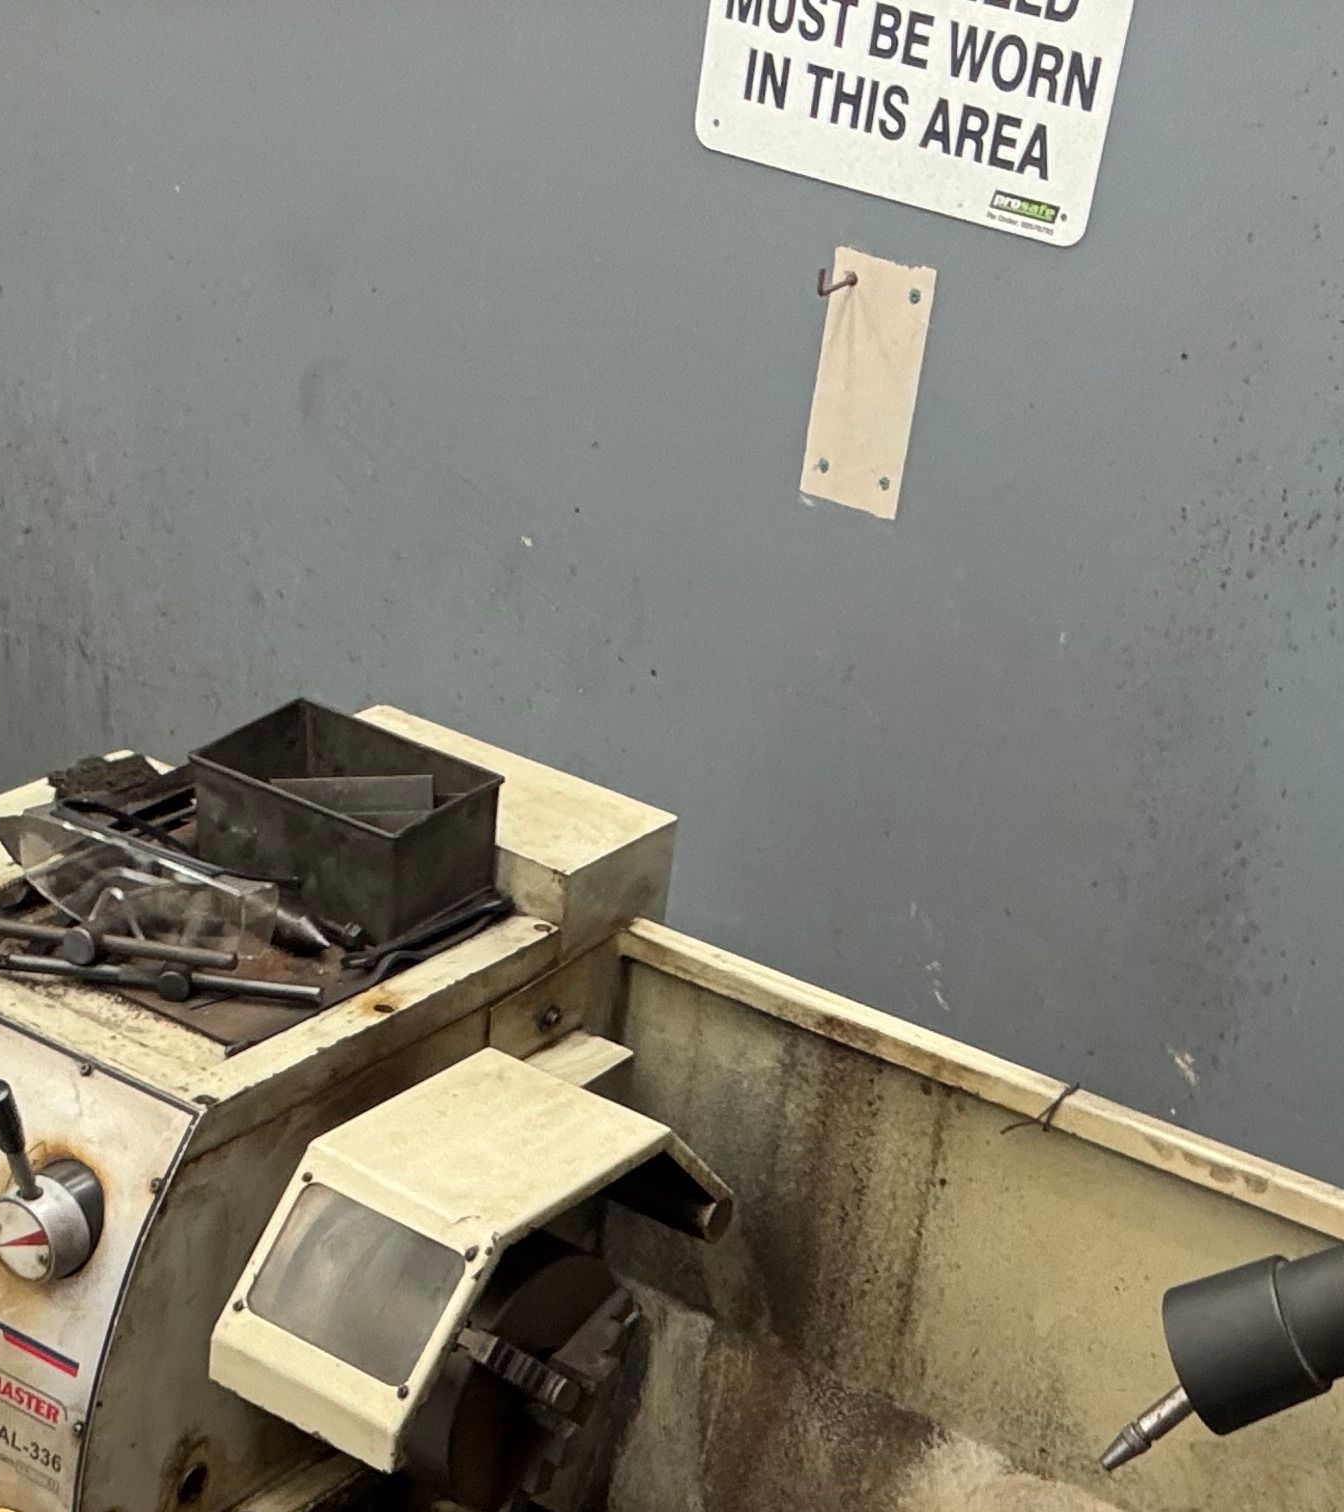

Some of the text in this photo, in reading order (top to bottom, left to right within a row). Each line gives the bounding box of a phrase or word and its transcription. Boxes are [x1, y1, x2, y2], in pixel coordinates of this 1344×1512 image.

[868, 2, 935, 70] BE
[950, 20, 1102, 112] WORN
[744, 48, 1049, 181] IN THIS AREA
[992, 193, 1057, 221] prosafe
